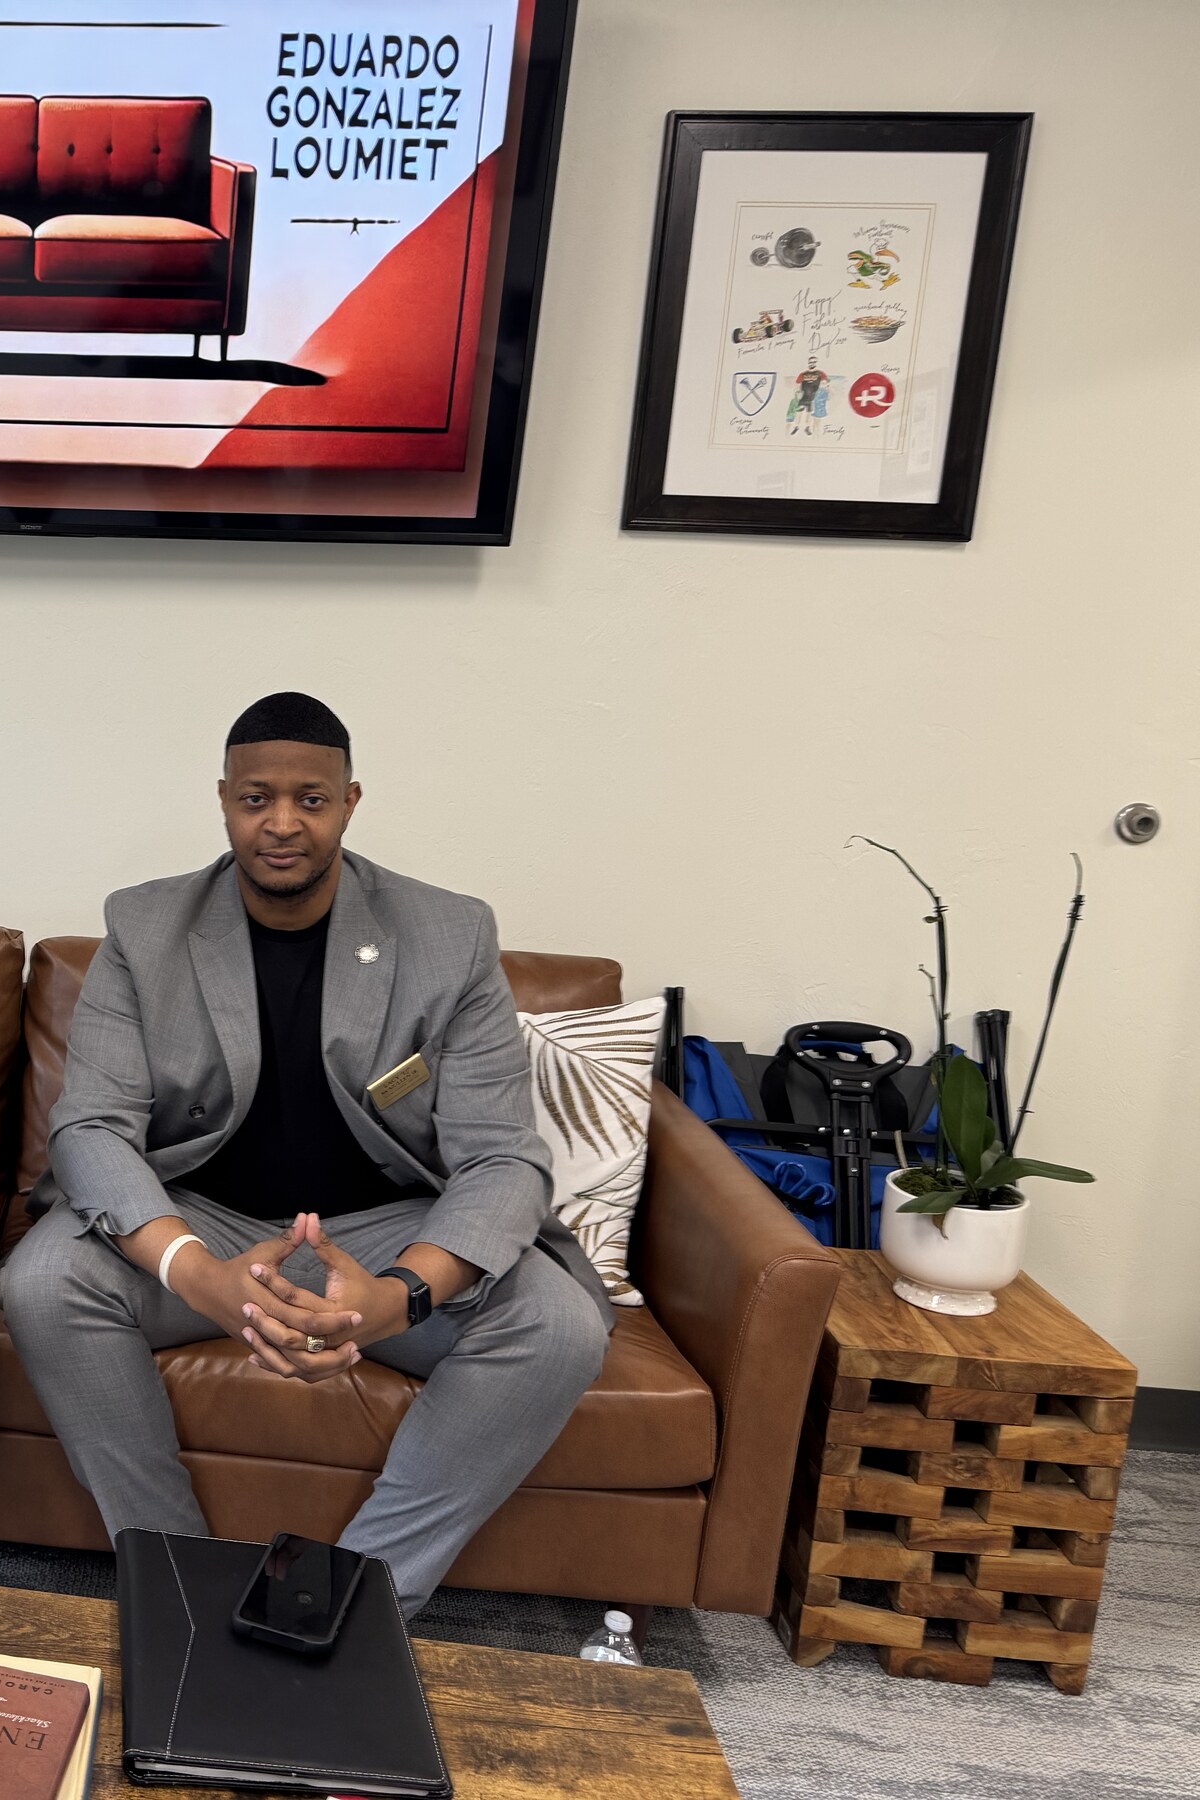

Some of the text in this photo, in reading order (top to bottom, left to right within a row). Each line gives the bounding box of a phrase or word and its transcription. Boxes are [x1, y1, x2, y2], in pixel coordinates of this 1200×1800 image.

[276, 32, 459, 79] EDUARDO
[267, 86, 461, 130] GONZALEZ
[270, 136, 448, 181] LOUMIET
[792, 287, 842, 316] Happy
[807, 323, 840, 358] Day
